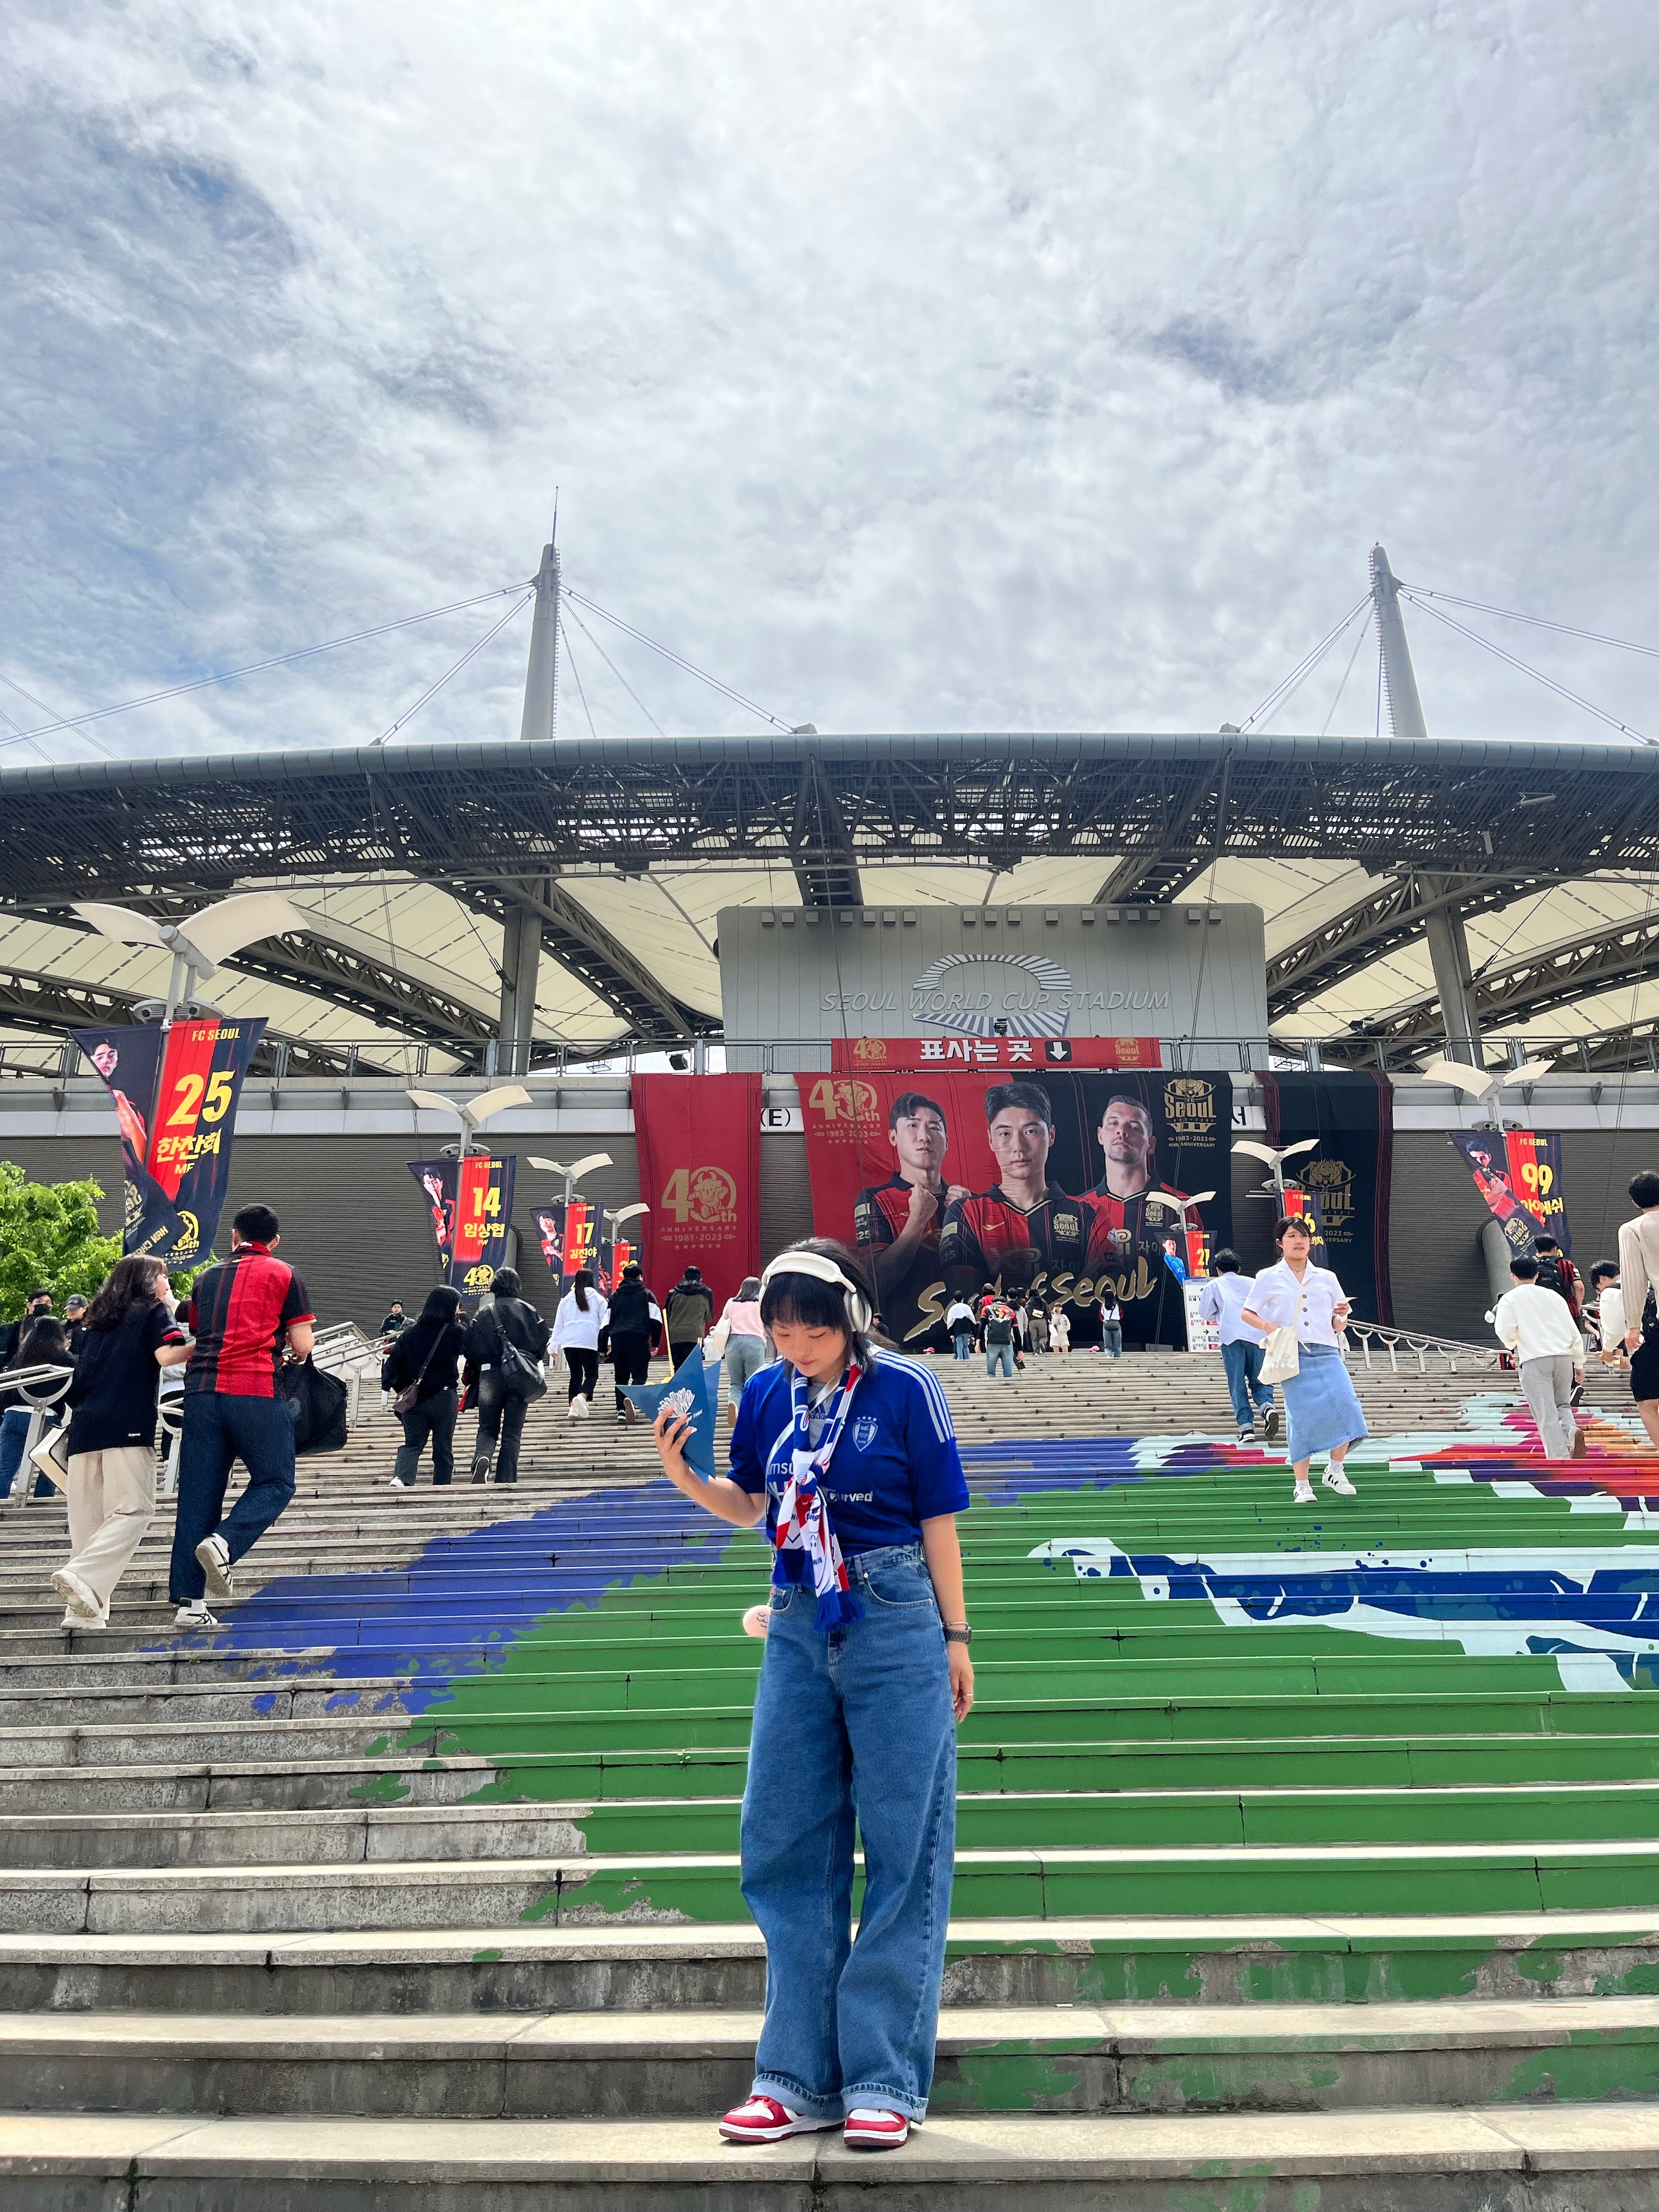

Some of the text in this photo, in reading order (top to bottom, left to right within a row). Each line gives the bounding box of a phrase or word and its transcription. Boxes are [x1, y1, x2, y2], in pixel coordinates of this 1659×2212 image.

[821, 991, 1170, 1012] SEOUL WORLD CUP STADIUM
[192, 1028, 240, 1041] FC SEOUL
[1007, 1040, 1033, 1062] 곳
[166, 1069, 236, 1126] 25
[156, 1128, 222, 1163] 한찬희
[1529, 1138, 1548, 1146] SEOUL
[1521, 1162, 1553, 1195] 99
[473, 1187, 501, 1217] 14
[464, 1222, 506, 1238] 임상협
[576, 1222, 594, 1244] 17
